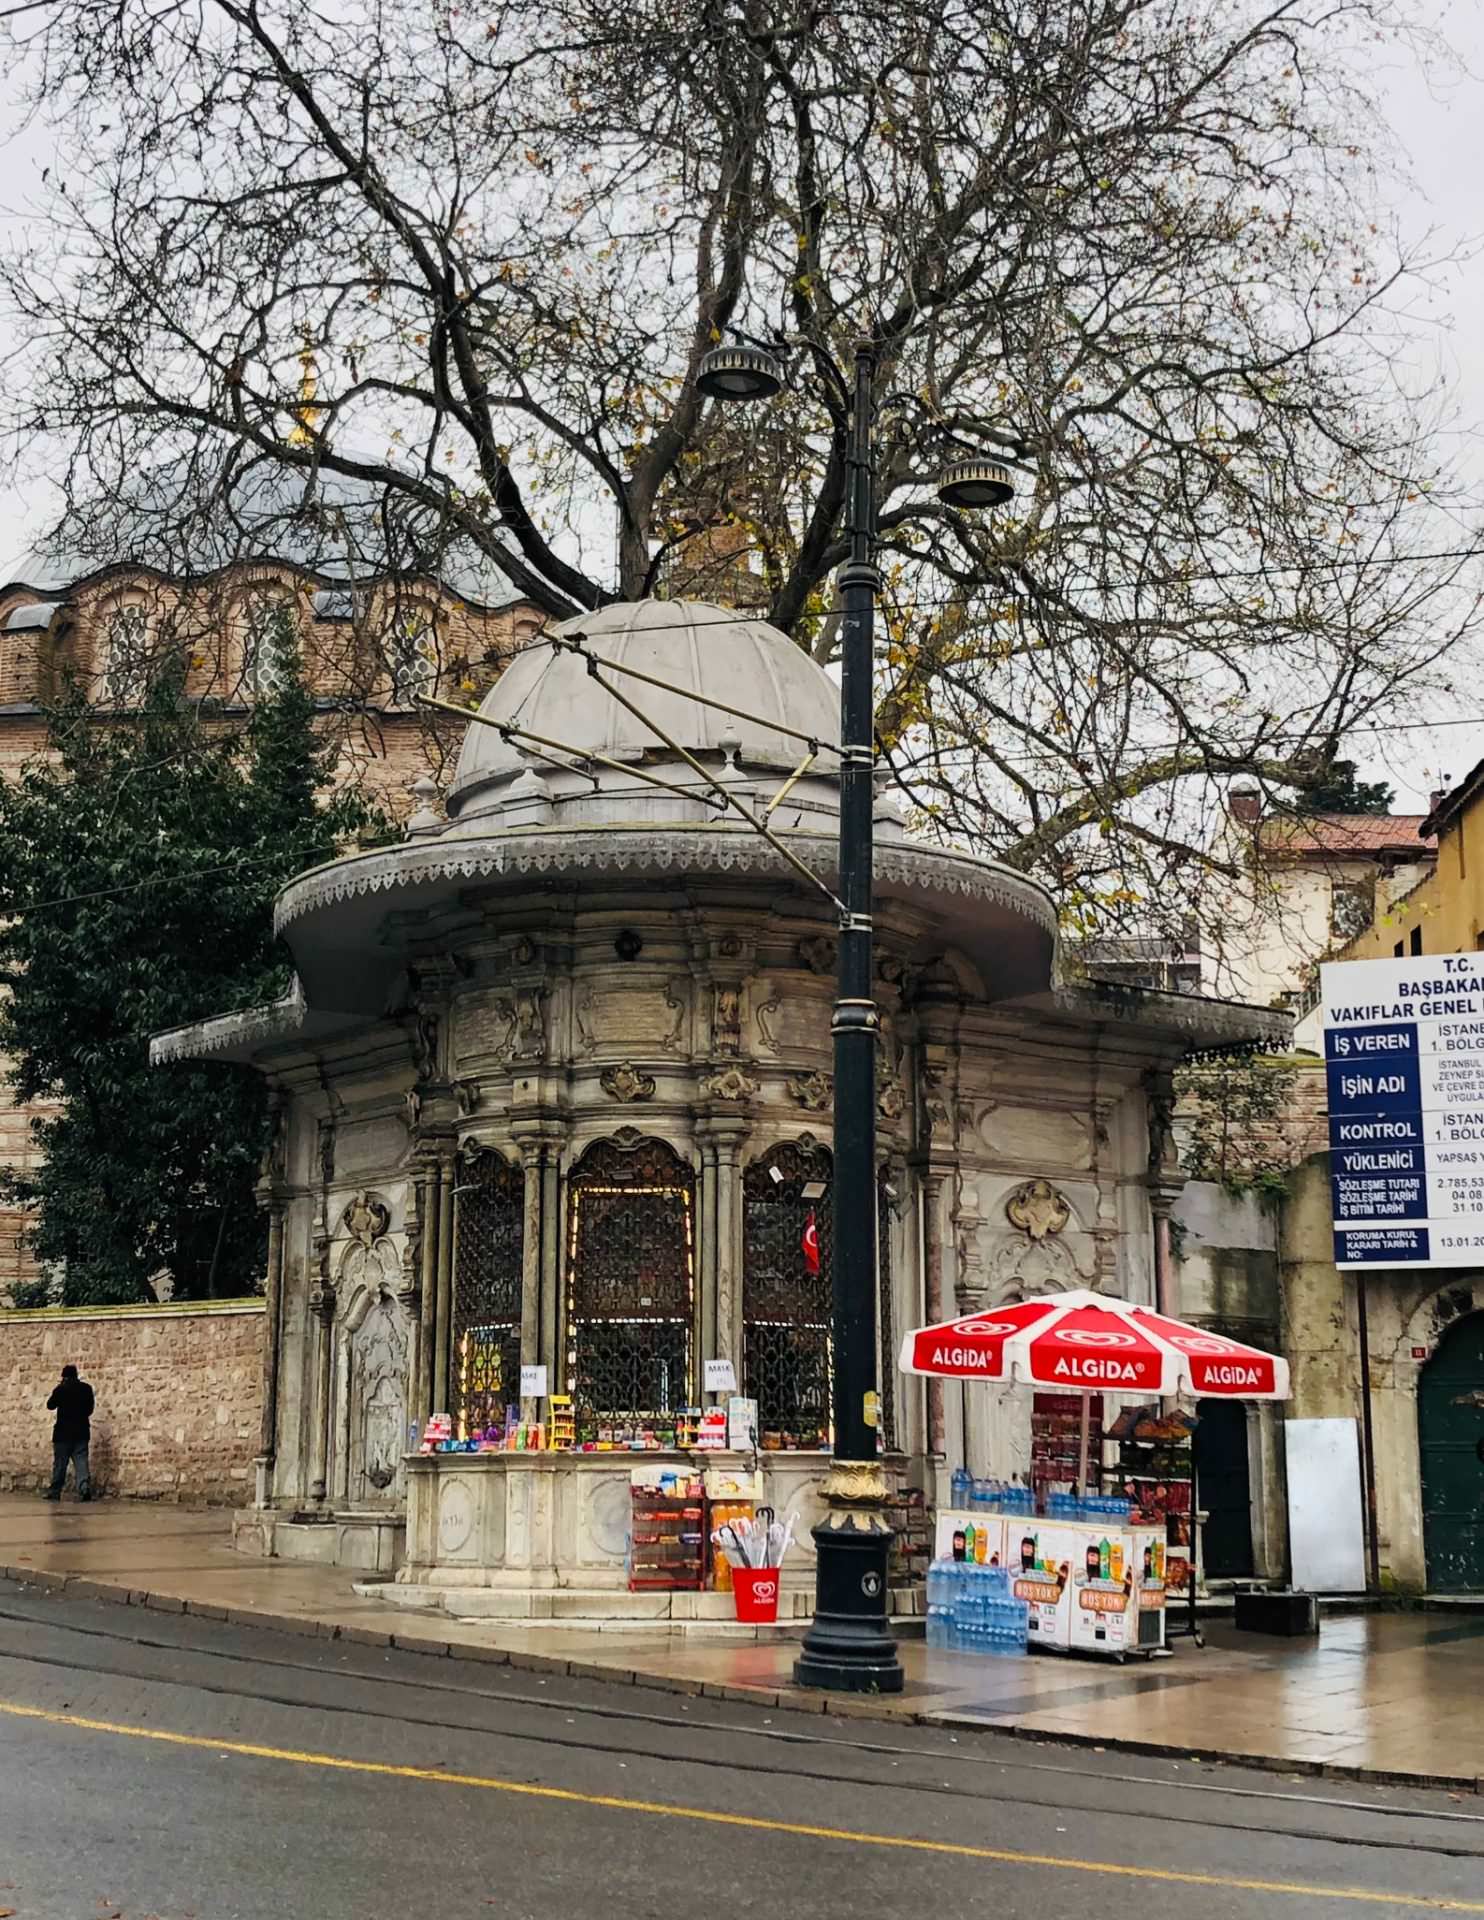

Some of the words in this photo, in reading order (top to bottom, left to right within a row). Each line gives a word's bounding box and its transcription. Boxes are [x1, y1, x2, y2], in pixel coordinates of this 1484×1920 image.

[1443, 958, 1474, 973] T.C.
[1331, 1003, 1414, 1022] VAKIFLAR
[1420, 999, 1477, 1016] GENEL
[1334, 1034, 1350, 1056] İŞ
[1353, 1033, 1410, 1051] VEREN
[1439, 1070, 1473, 1081] ZEYNEP
[1341, 1074, 1373, 1099] İŞİN
[1376, 1076, 1405, 1093] ADI
[1432, 1082, 1445, 1092] VE
[1340, 1122, 1417, 1140] KONTROL
[1343, 1149, 1414, 1171] YÜKLENİCİ
[1436, 1152, 1477, 1164] YAPSAŞ
[1339, 1178, 1386, 1191] SÖZLEŞME
[1388, 1178, 1420, 1190] TUTARI
[1339, 1190, 1387, 1203] SÖZLEŞME
[1388, 1189, 1418, 1201] TARİHİ
[1376, 1201, 1405, 1214] TARİHİ
[1345, 1231, 1385, 1241] KORUMA
[1386, 1230, 1418, 1239] KURUL
[1346, 1240, 1381, 1250] KARARI
